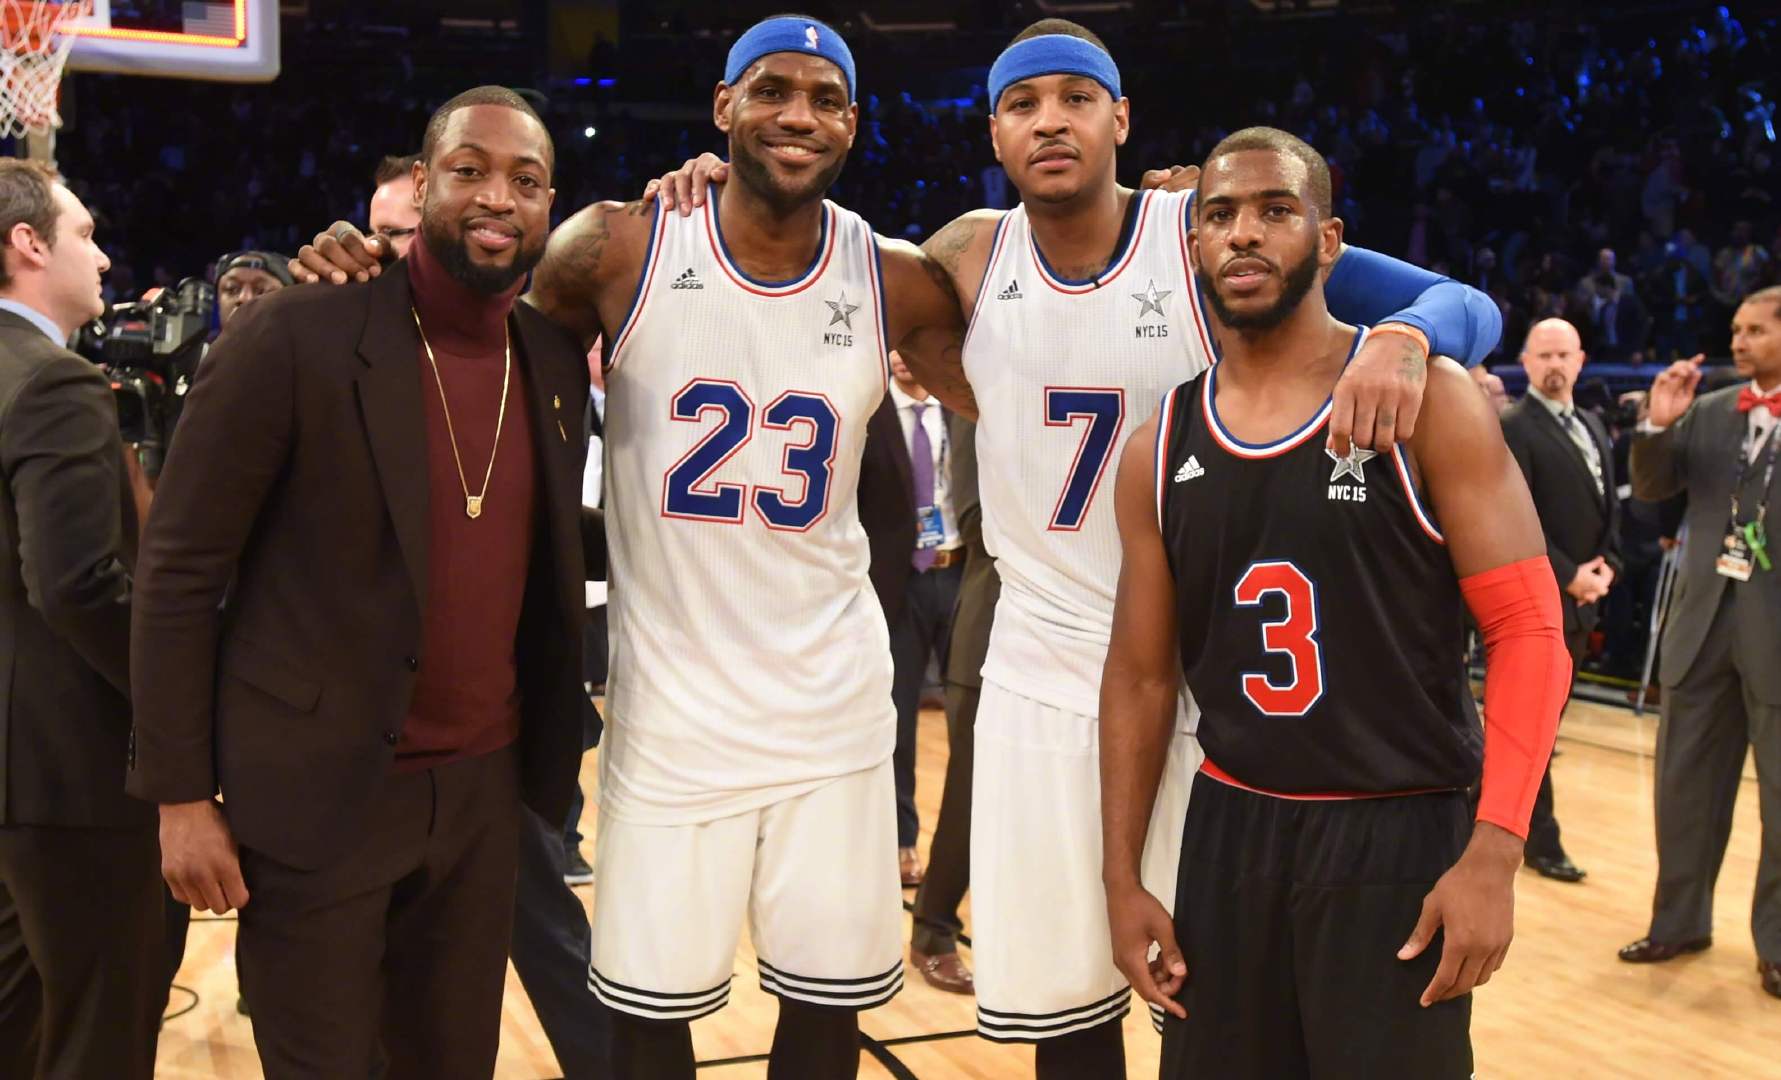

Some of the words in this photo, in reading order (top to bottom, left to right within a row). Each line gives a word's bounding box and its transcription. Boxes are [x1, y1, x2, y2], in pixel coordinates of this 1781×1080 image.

[671, 280, 704, 289] adidas
[1135, 325, 1155, 338] NYC
[1157, 324, 1168, 338] 15
[823, 333, 842, 346] NYC
[843, 335, 853, 347] 15
[661, 377, 840, 533] 23
[1044, 386, 1125, 531] 7
[1174, 467, 1205, 483] adidas
[1328, 485, 1351, 501] NYC
[1352, 486, 1367, 503] 15
[1233, 559, 1325, 717] 3
